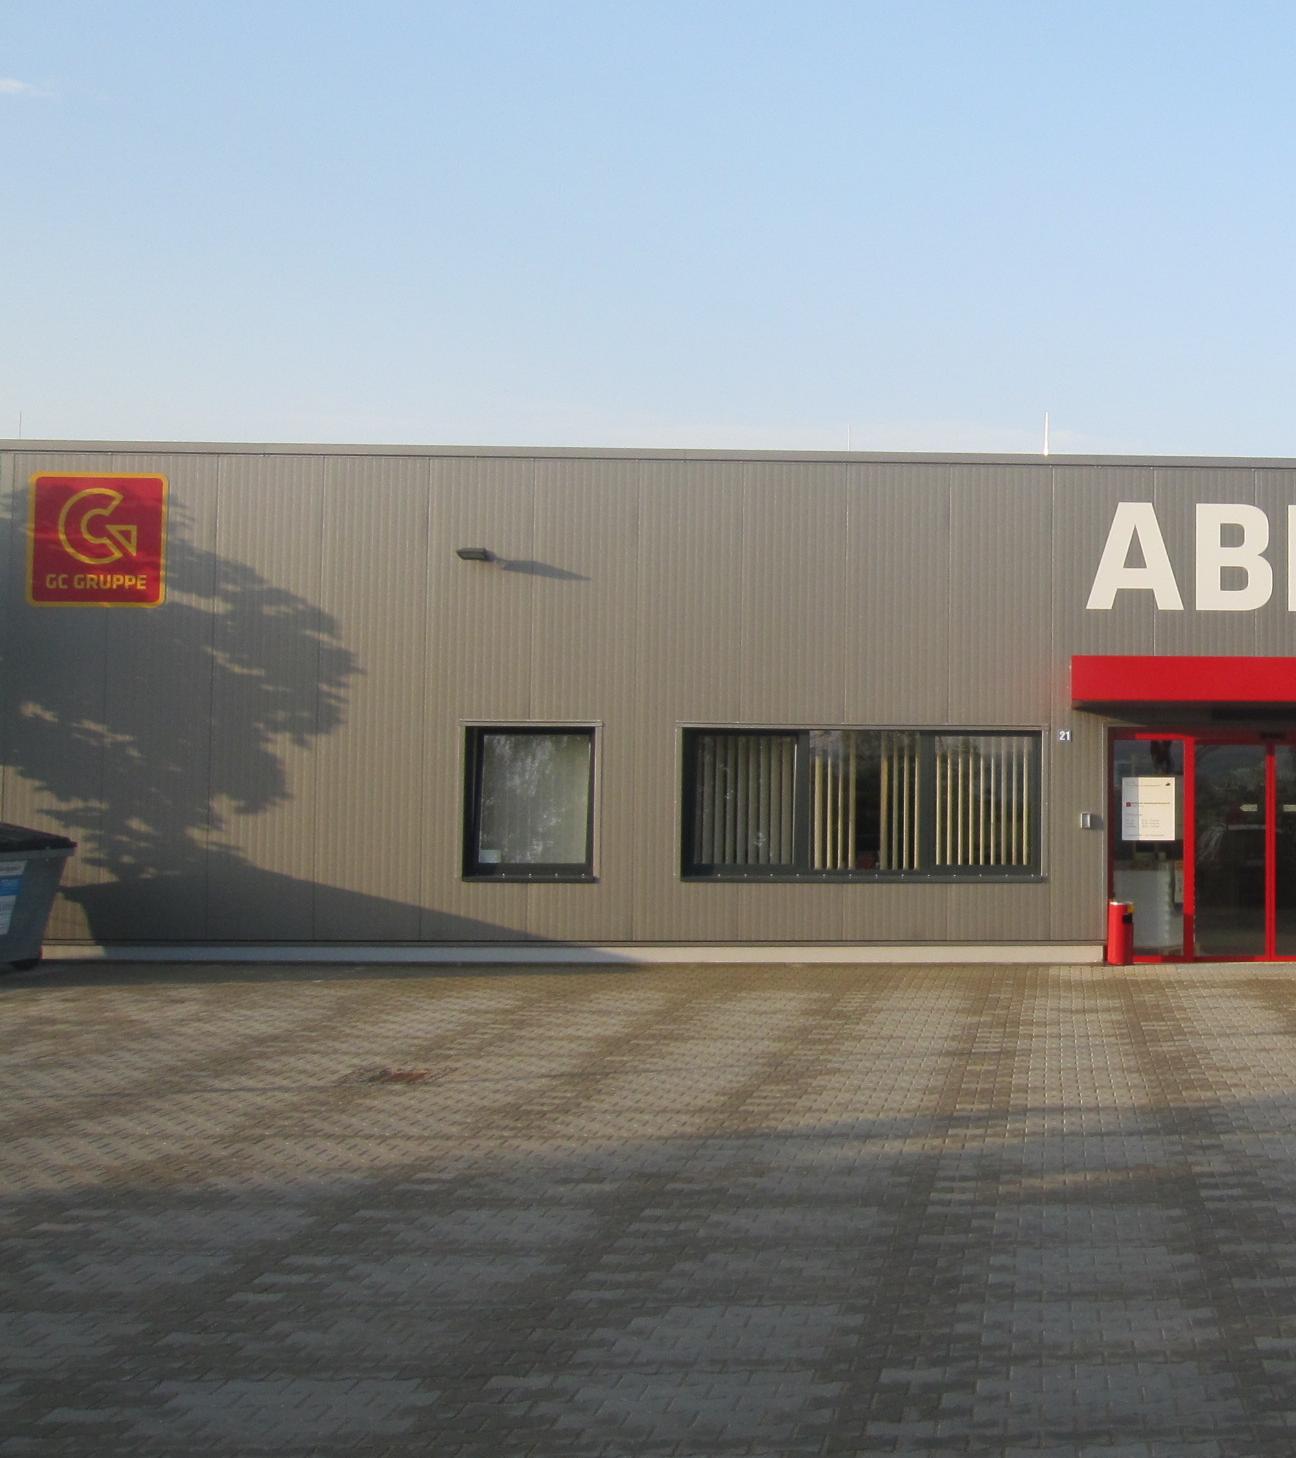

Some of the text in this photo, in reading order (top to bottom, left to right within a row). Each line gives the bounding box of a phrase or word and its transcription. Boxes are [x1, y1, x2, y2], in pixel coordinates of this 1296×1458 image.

[46, 574, 147, 590] GC GRUPPE
[1059, 730, 1070, 741] 21
